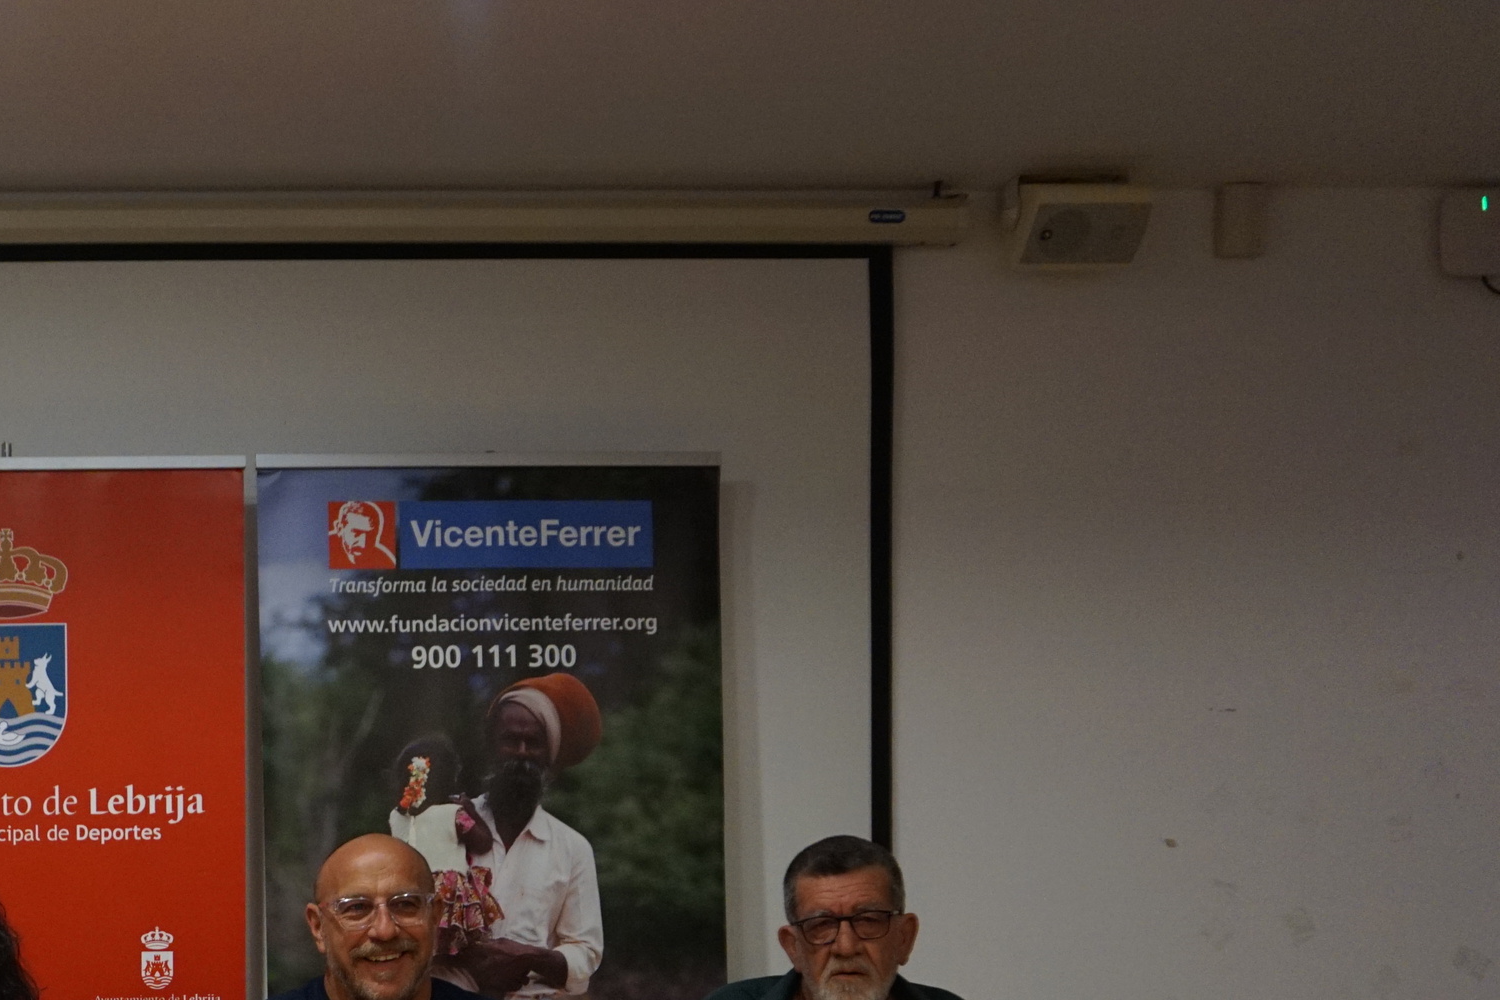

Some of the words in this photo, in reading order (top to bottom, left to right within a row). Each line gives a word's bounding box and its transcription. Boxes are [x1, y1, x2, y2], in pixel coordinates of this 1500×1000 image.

[410, 518, 641, 548] VicenteFerrer
[329, 578, 426, 597] Transforma
[431, 577, 447, 593] la
[451, 575, 527, 593] sociedad
[532, 580, 552, 592] en
[556, 575, 654, 592] humanidad
[328, 613, 658, 635] www.fundacionvicenteferrer.org
[411, 645, 461, 669] 900
[472, 645, 518, 668] 111
[528, 644, 577, 668] 300
[43, 785, 78, 816] de
[88, 784, 205, 824] Lebrija
[47, 825, 70, 842] de
[76, 824, 162, 844] Deportes
